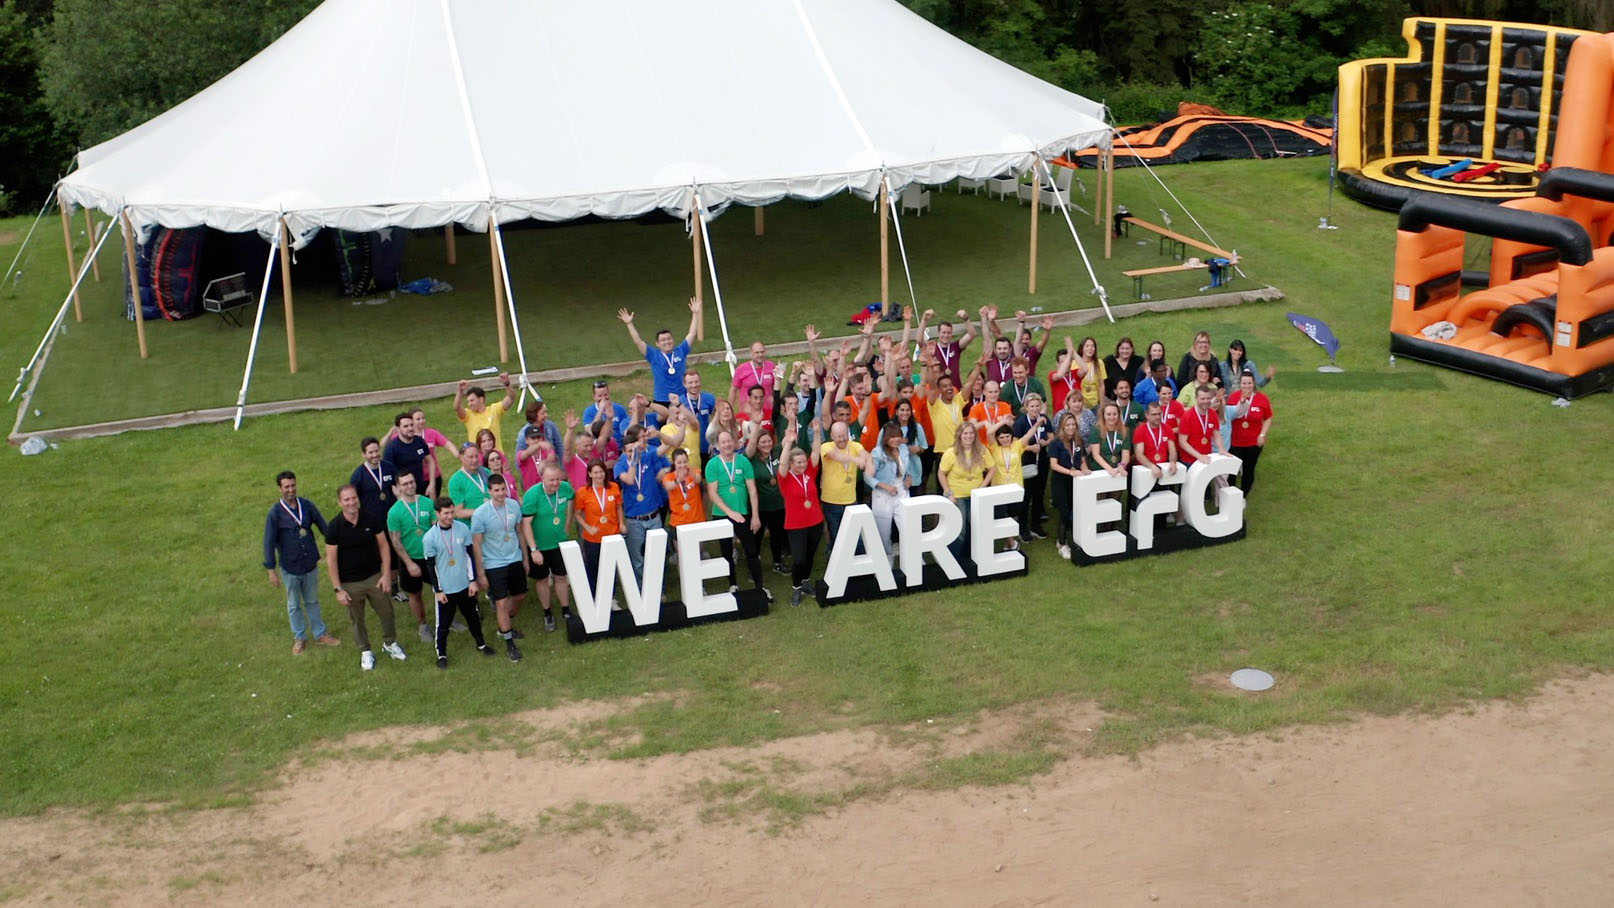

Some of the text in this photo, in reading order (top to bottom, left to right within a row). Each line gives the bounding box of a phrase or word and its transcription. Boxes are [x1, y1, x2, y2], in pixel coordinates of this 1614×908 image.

[558, 453, 1244, 634] WE ARE EFG
